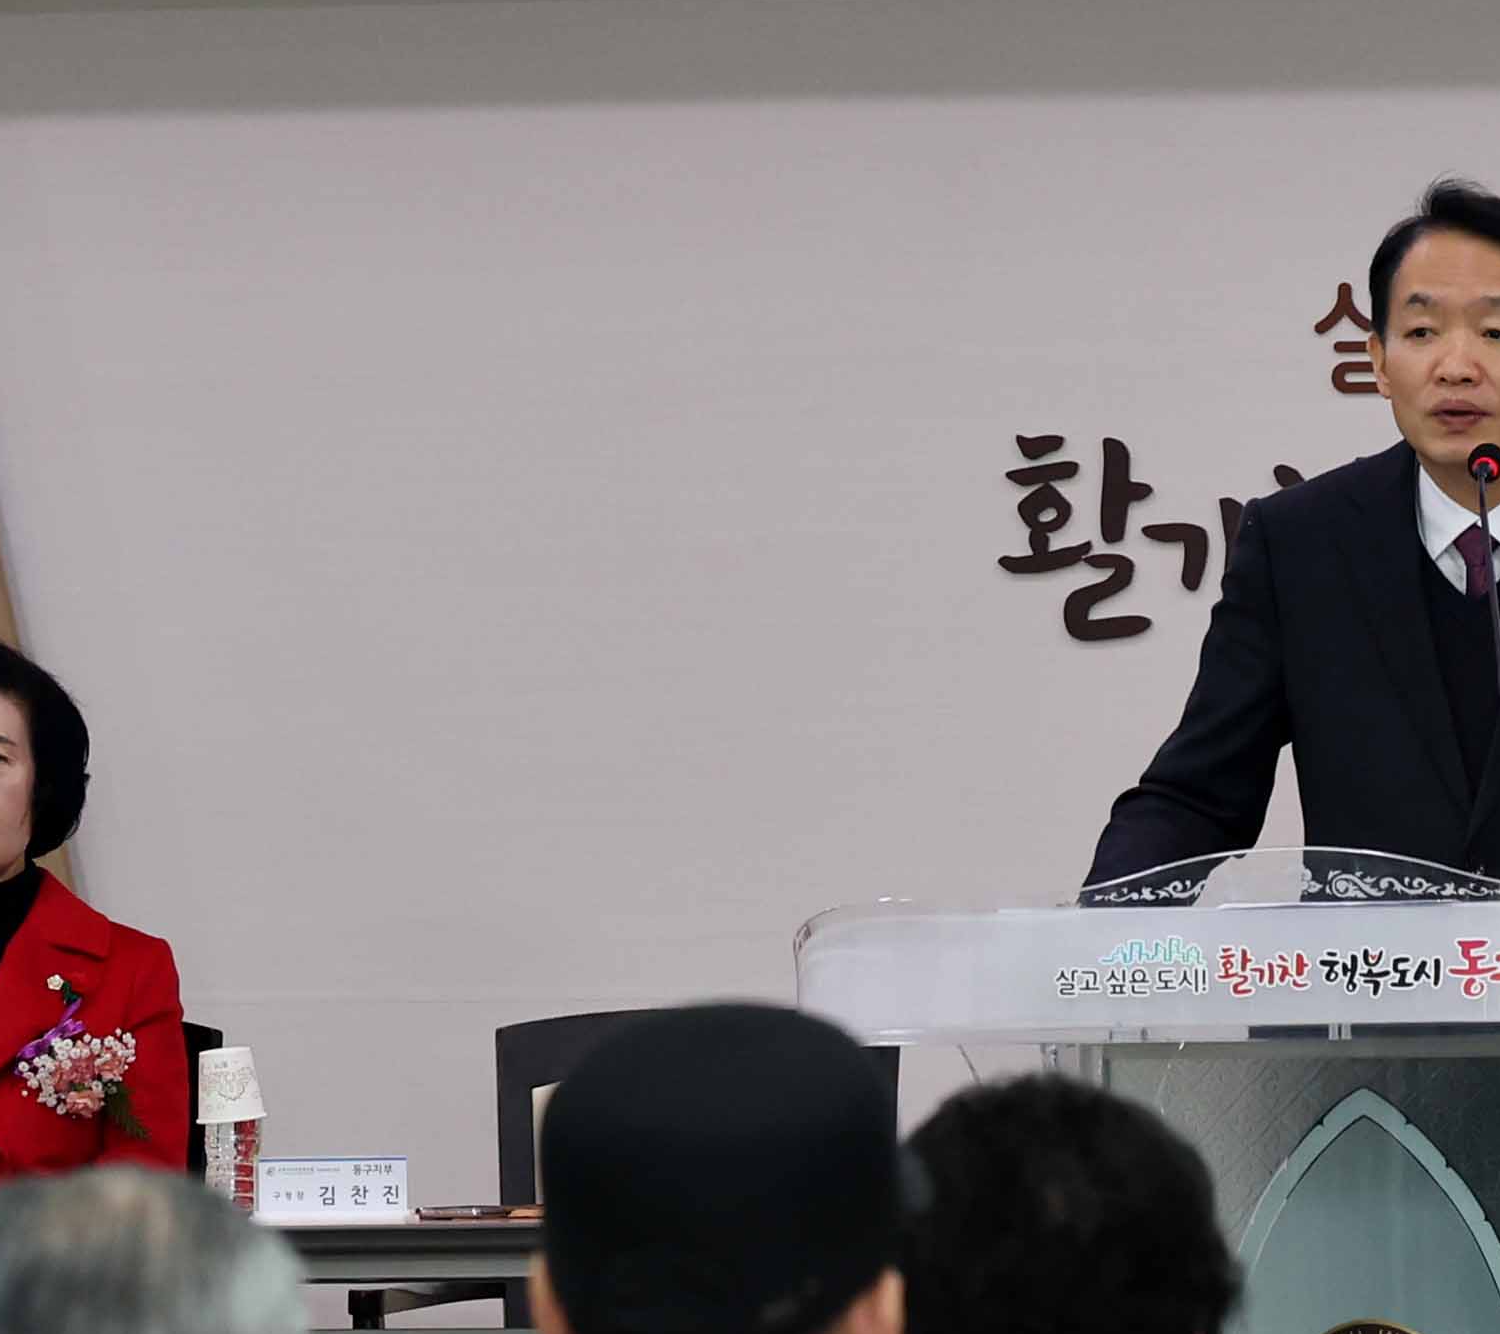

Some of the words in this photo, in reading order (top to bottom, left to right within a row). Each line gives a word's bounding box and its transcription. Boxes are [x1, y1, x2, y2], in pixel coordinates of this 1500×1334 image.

[997, 434, 1306, 643] 활기
[1055, 968, 1099, 996] 살고
[1106, 968, 1151, 996] 싶은
[1156, 966, 1208, 995] 도시!
[1217, 948, 1308, 995] 활기찬
[1319, 948, 1442, 997] 행복도시
